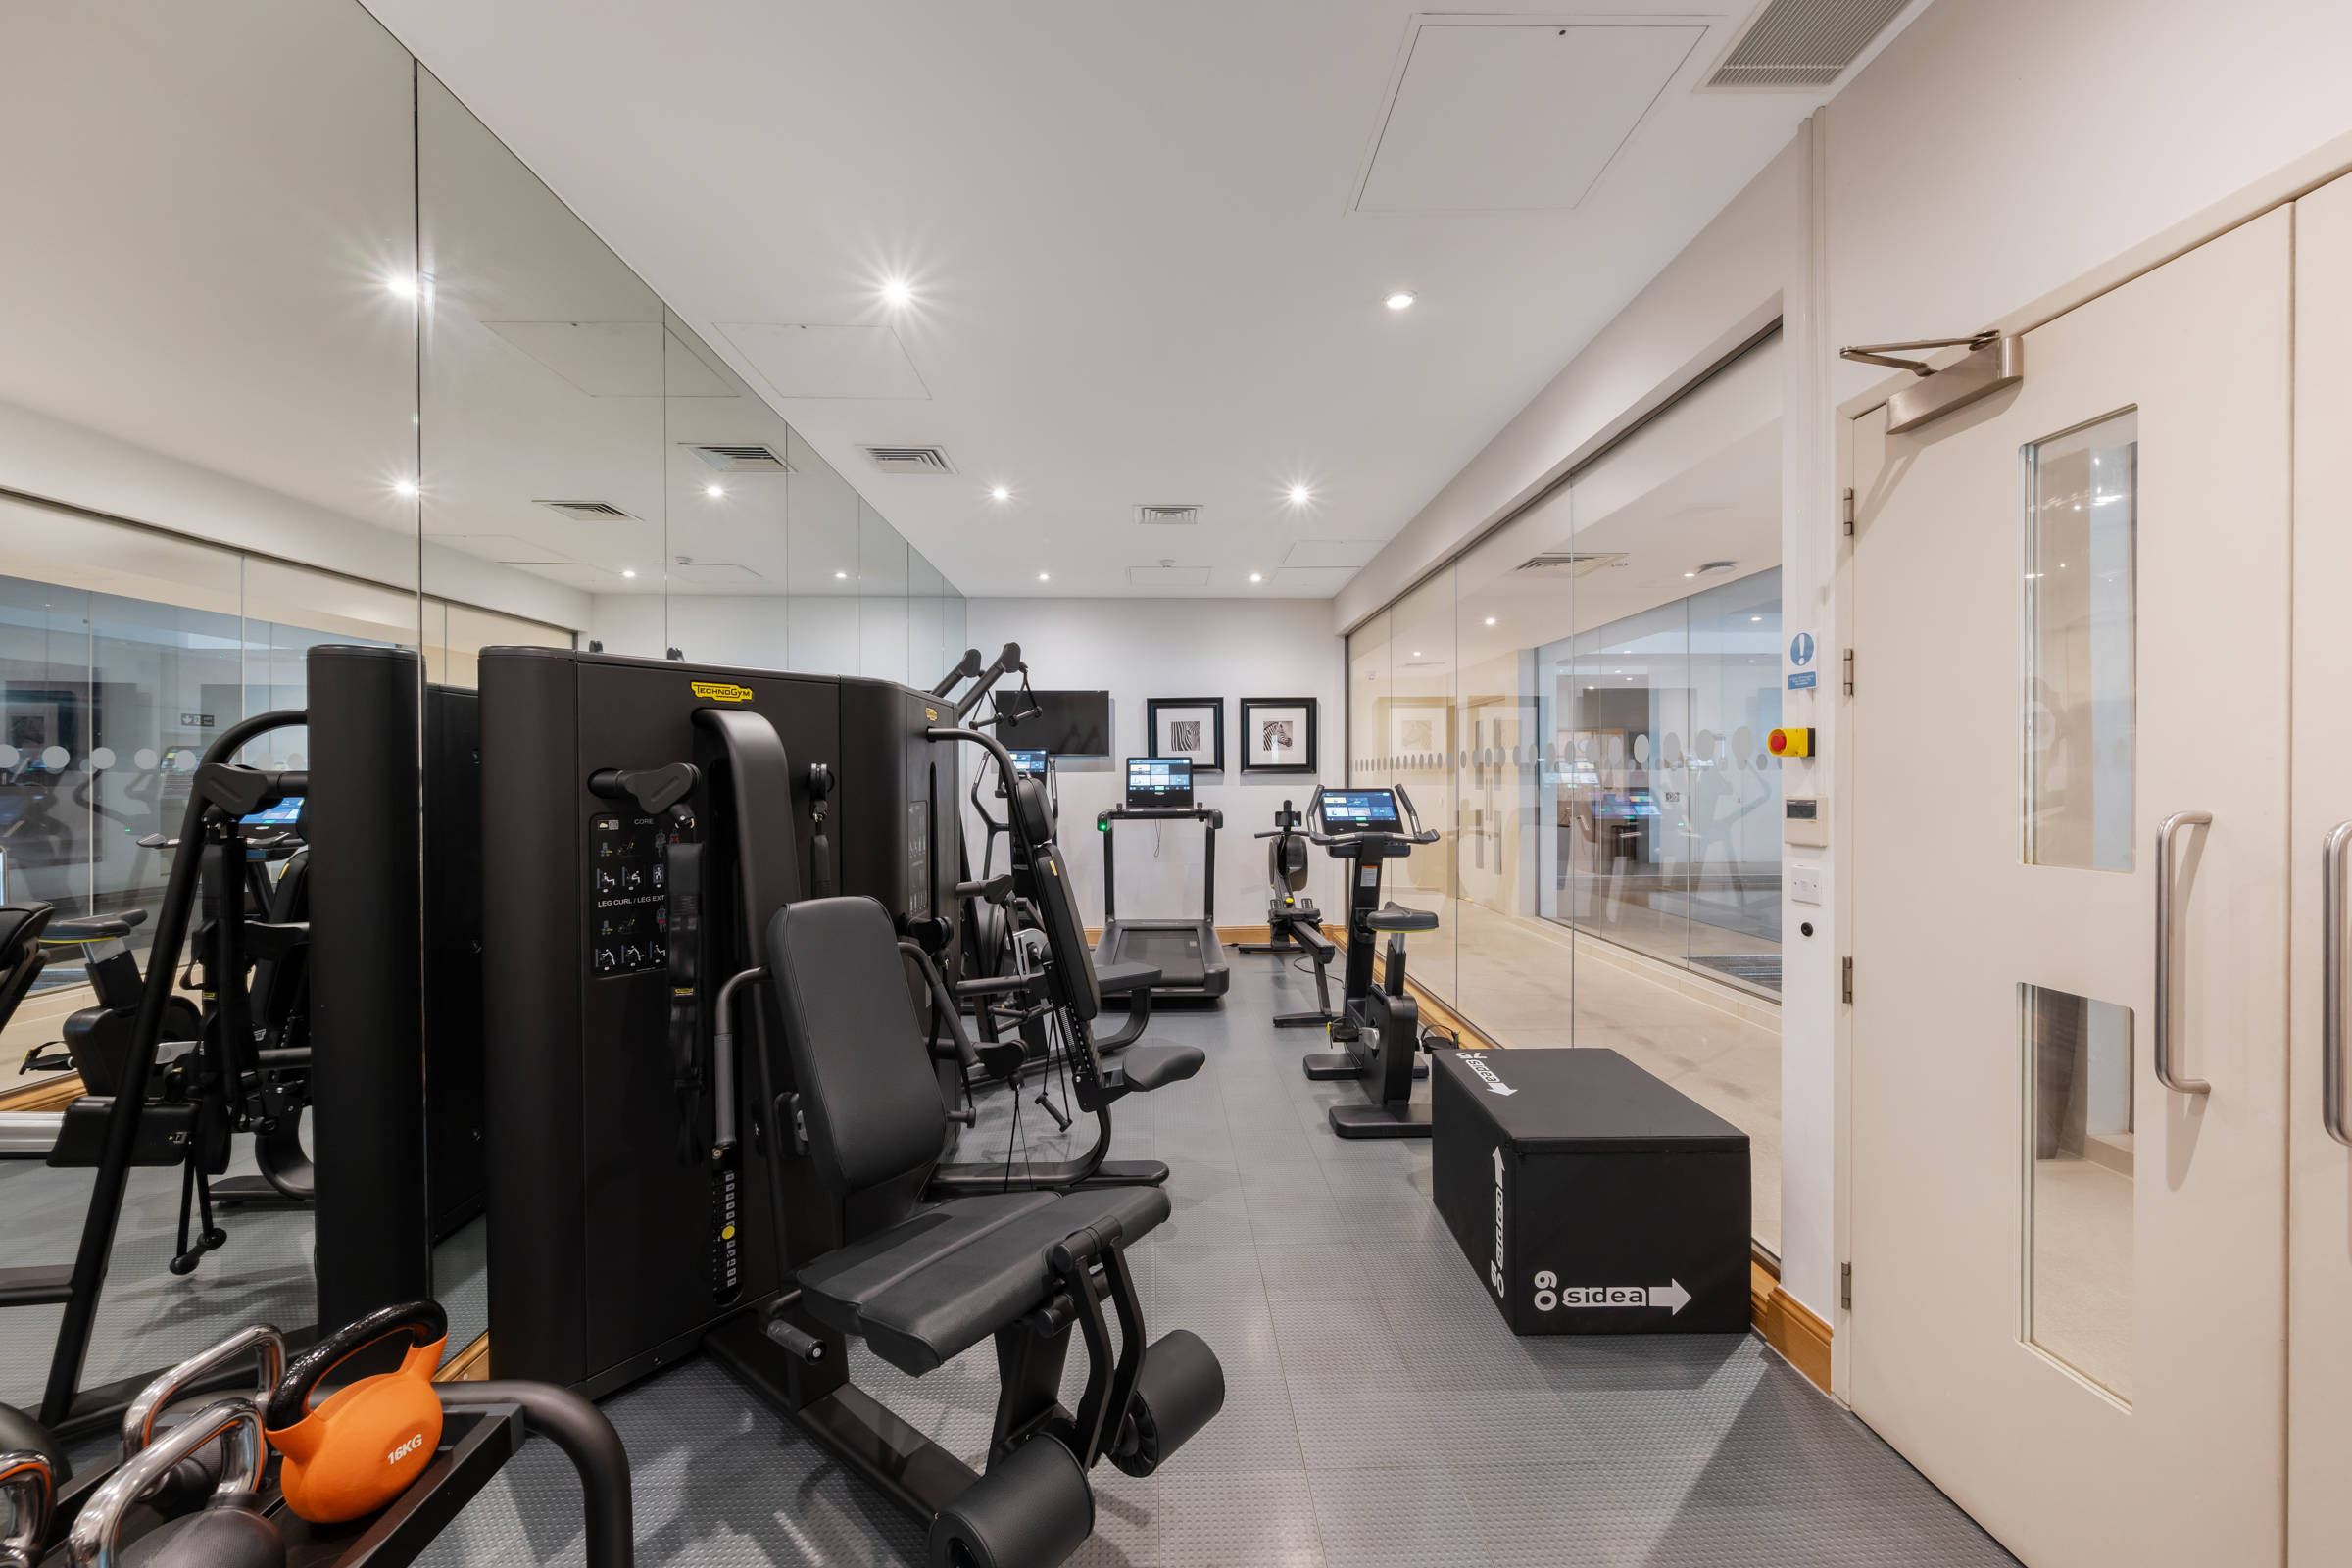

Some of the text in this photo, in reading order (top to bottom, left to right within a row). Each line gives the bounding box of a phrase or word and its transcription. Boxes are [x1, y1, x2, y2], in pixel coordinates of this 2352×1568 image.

[598, 899, 612, 907] LEG
[613, 897, 632, 906] CURL
[1466, 1059, 1499, 1082] sidea
[1534, 1270, 1558, 1311] 60
[1565, 1287, 1645, 1305] sidea
[387, 1433, 422, 1465] 16KG
